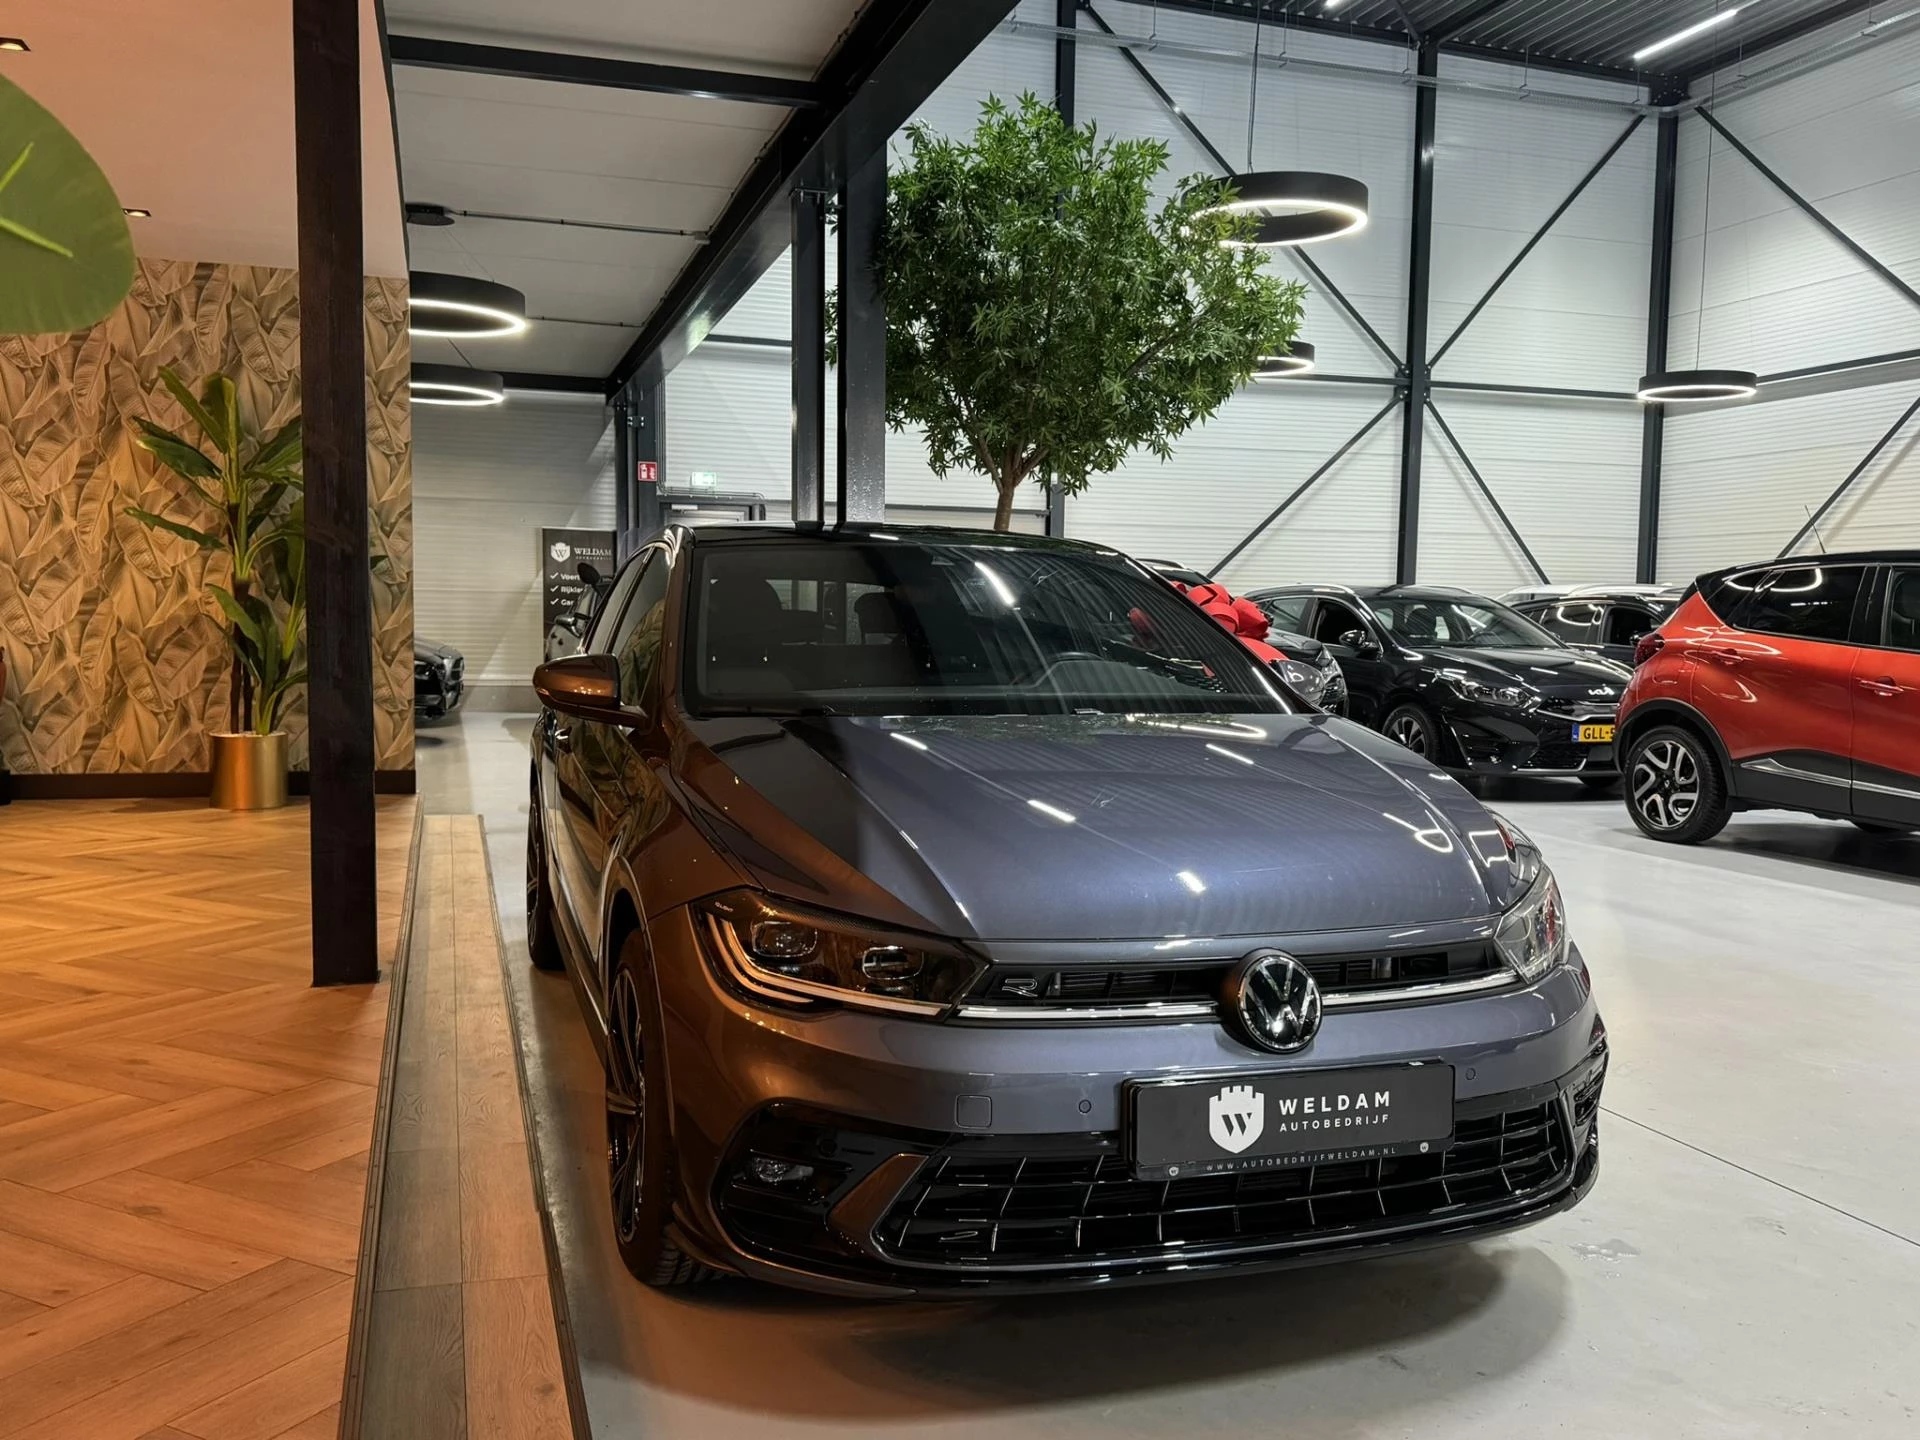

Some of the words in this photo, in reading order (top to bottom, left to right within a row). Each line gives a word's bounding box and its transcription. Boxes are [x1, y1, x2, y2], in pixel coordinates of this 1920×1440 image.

[1279, 1091, 1390, 1116] WELDAM
[1279, 1114, 1389, 1133] AUTOBEDRIJF
[1206, 1147, 1396, 1171] WWW.AUTOBEDRIJFWELDAM.NL
